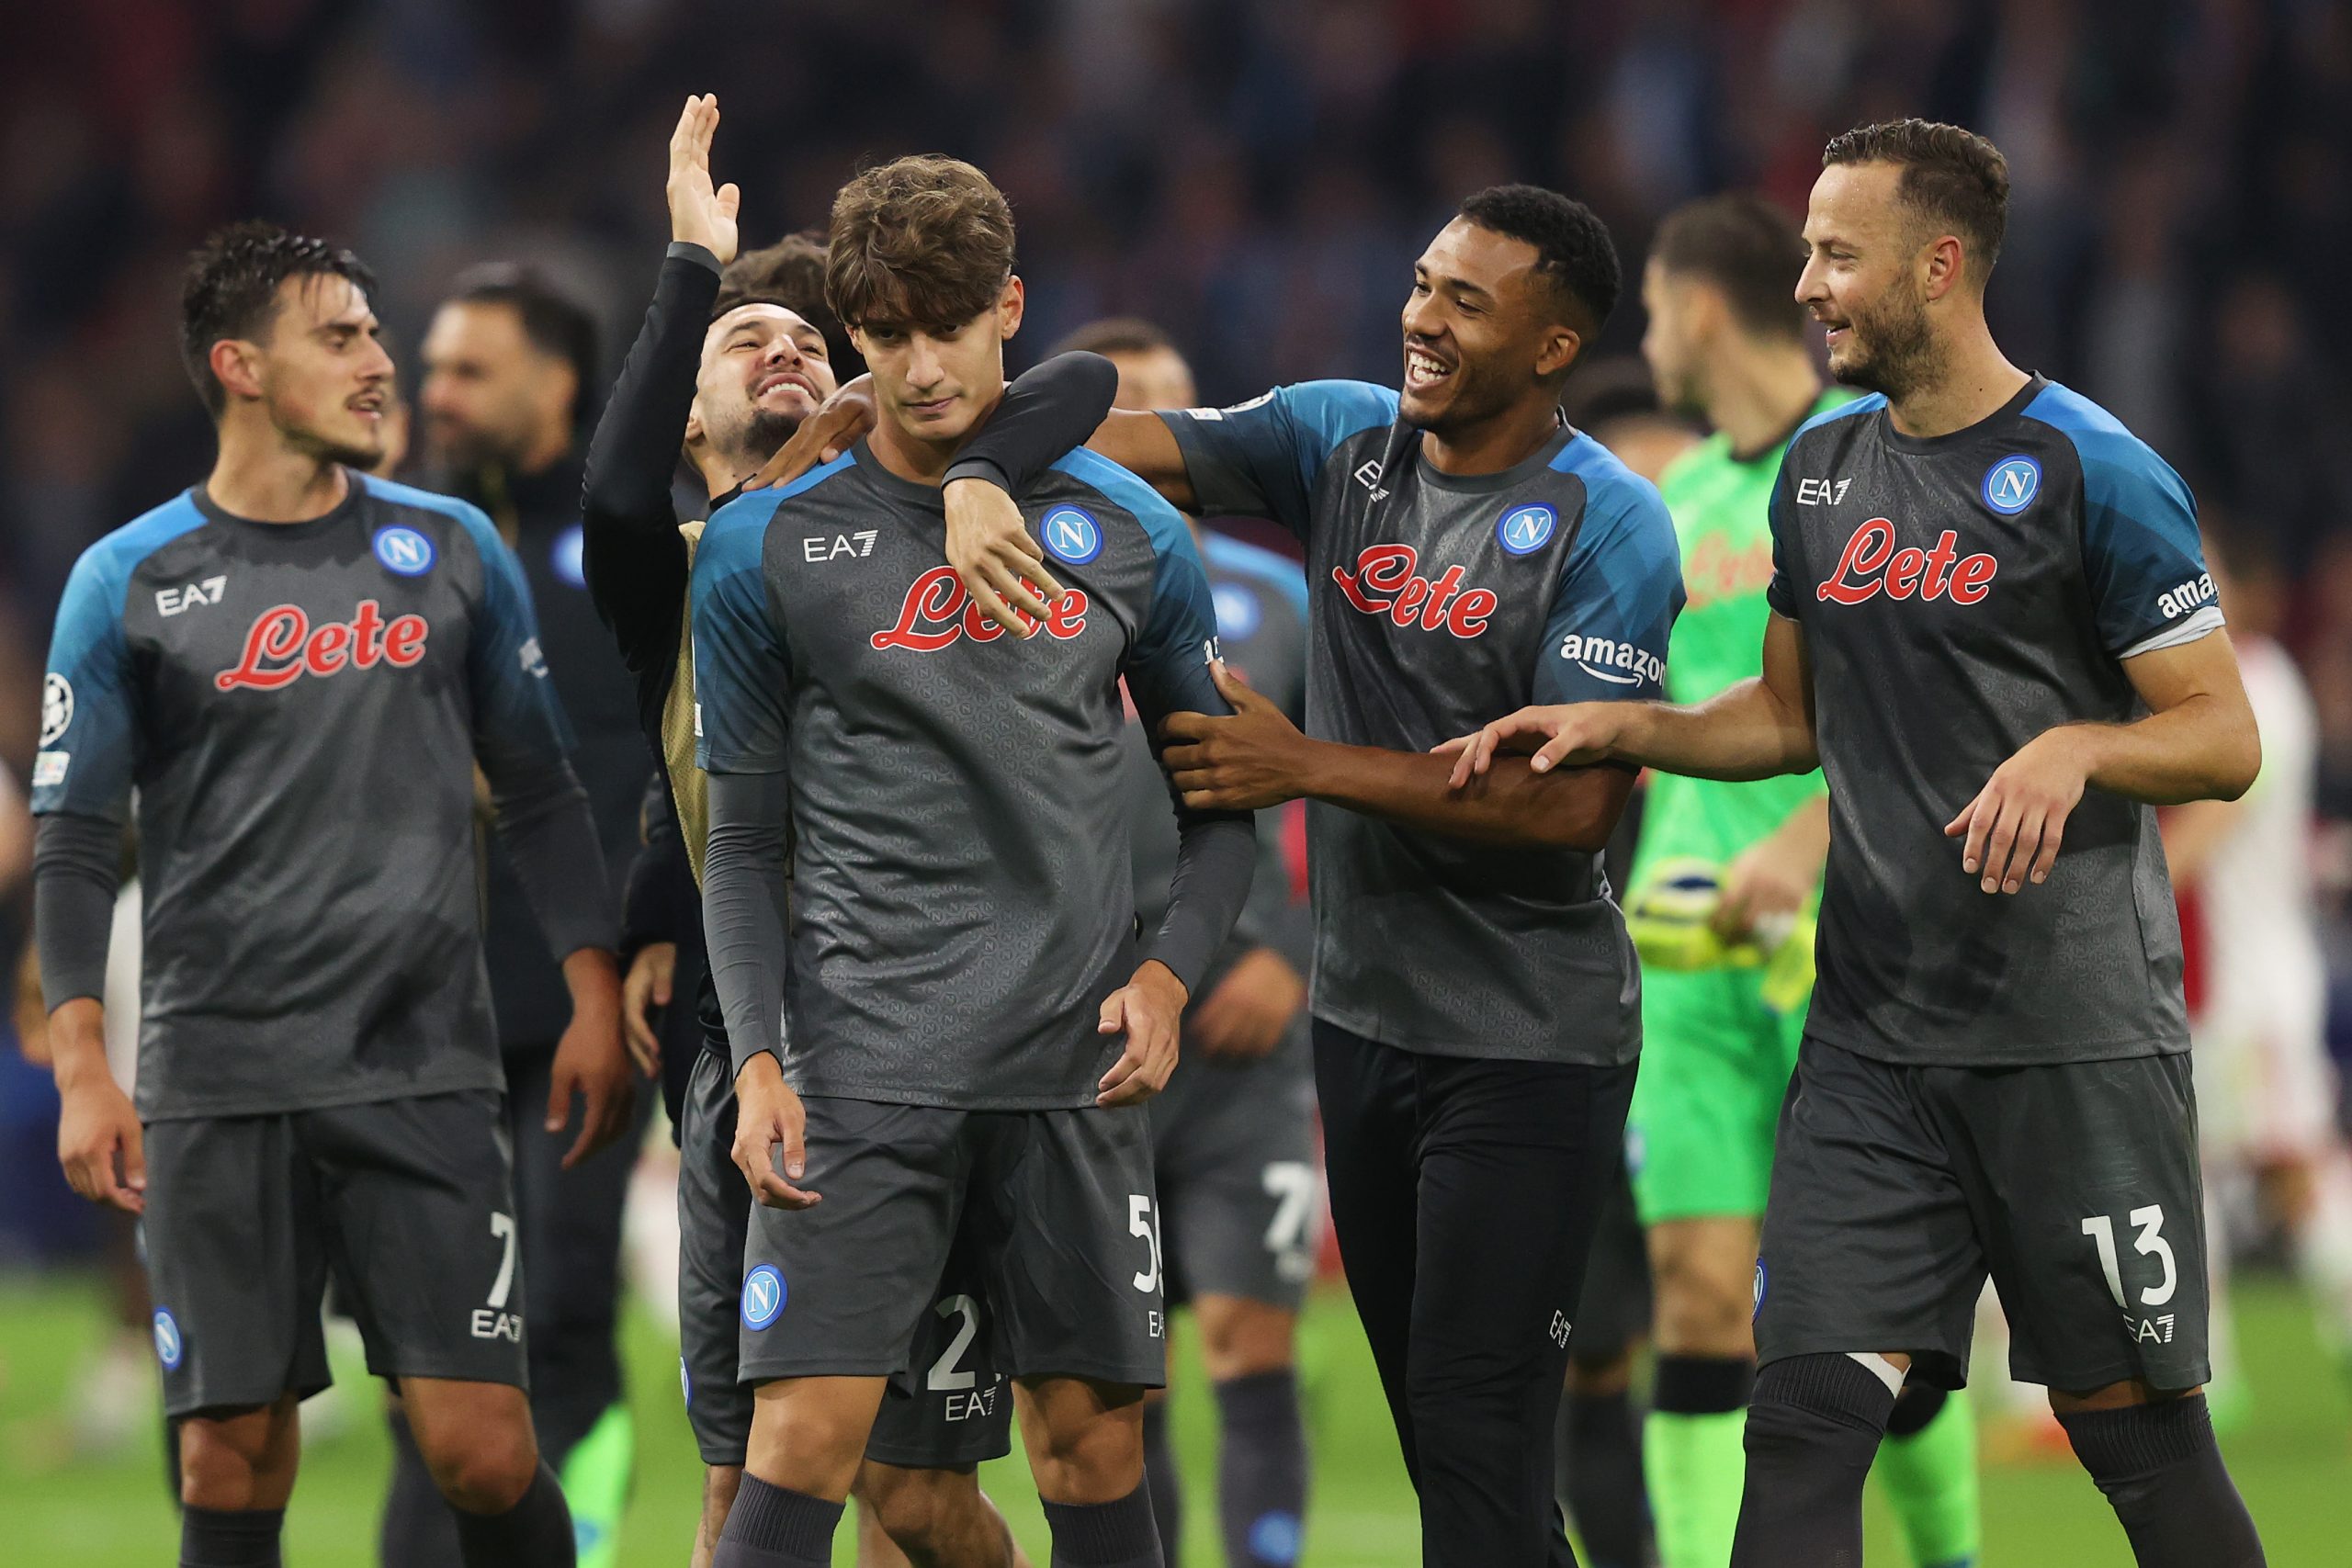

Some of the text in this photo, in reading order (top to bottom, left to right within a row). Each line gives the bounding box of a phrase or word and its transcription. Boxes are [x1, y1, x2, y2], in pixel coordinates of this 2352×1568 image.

[1796, 478, 1852, 506] EA7
[1996, 469, 2031, 500] N
[803, 529, 879, 563] EA7
[1057, 520, 1085, 549] N
[1511, 514, 1546, 542] N
[388, 536, 422, 564] N
[1816, 516, 1998, 606] Lete
[154, 574, 228, 618] EA7
[1332, 543, 1498, 639] Lete
[2157, 572, 2220, 619] ama
[213, 598, 429, 694] Lete
[486, 1211, 516, 1309] 7
[2081, 1203, 2177, 1310] 13
[749, 1279, 772, 1314] N
[1549, 1308, 1573, 1349] EA7
[944, 1385, 997, 1422] EA7
